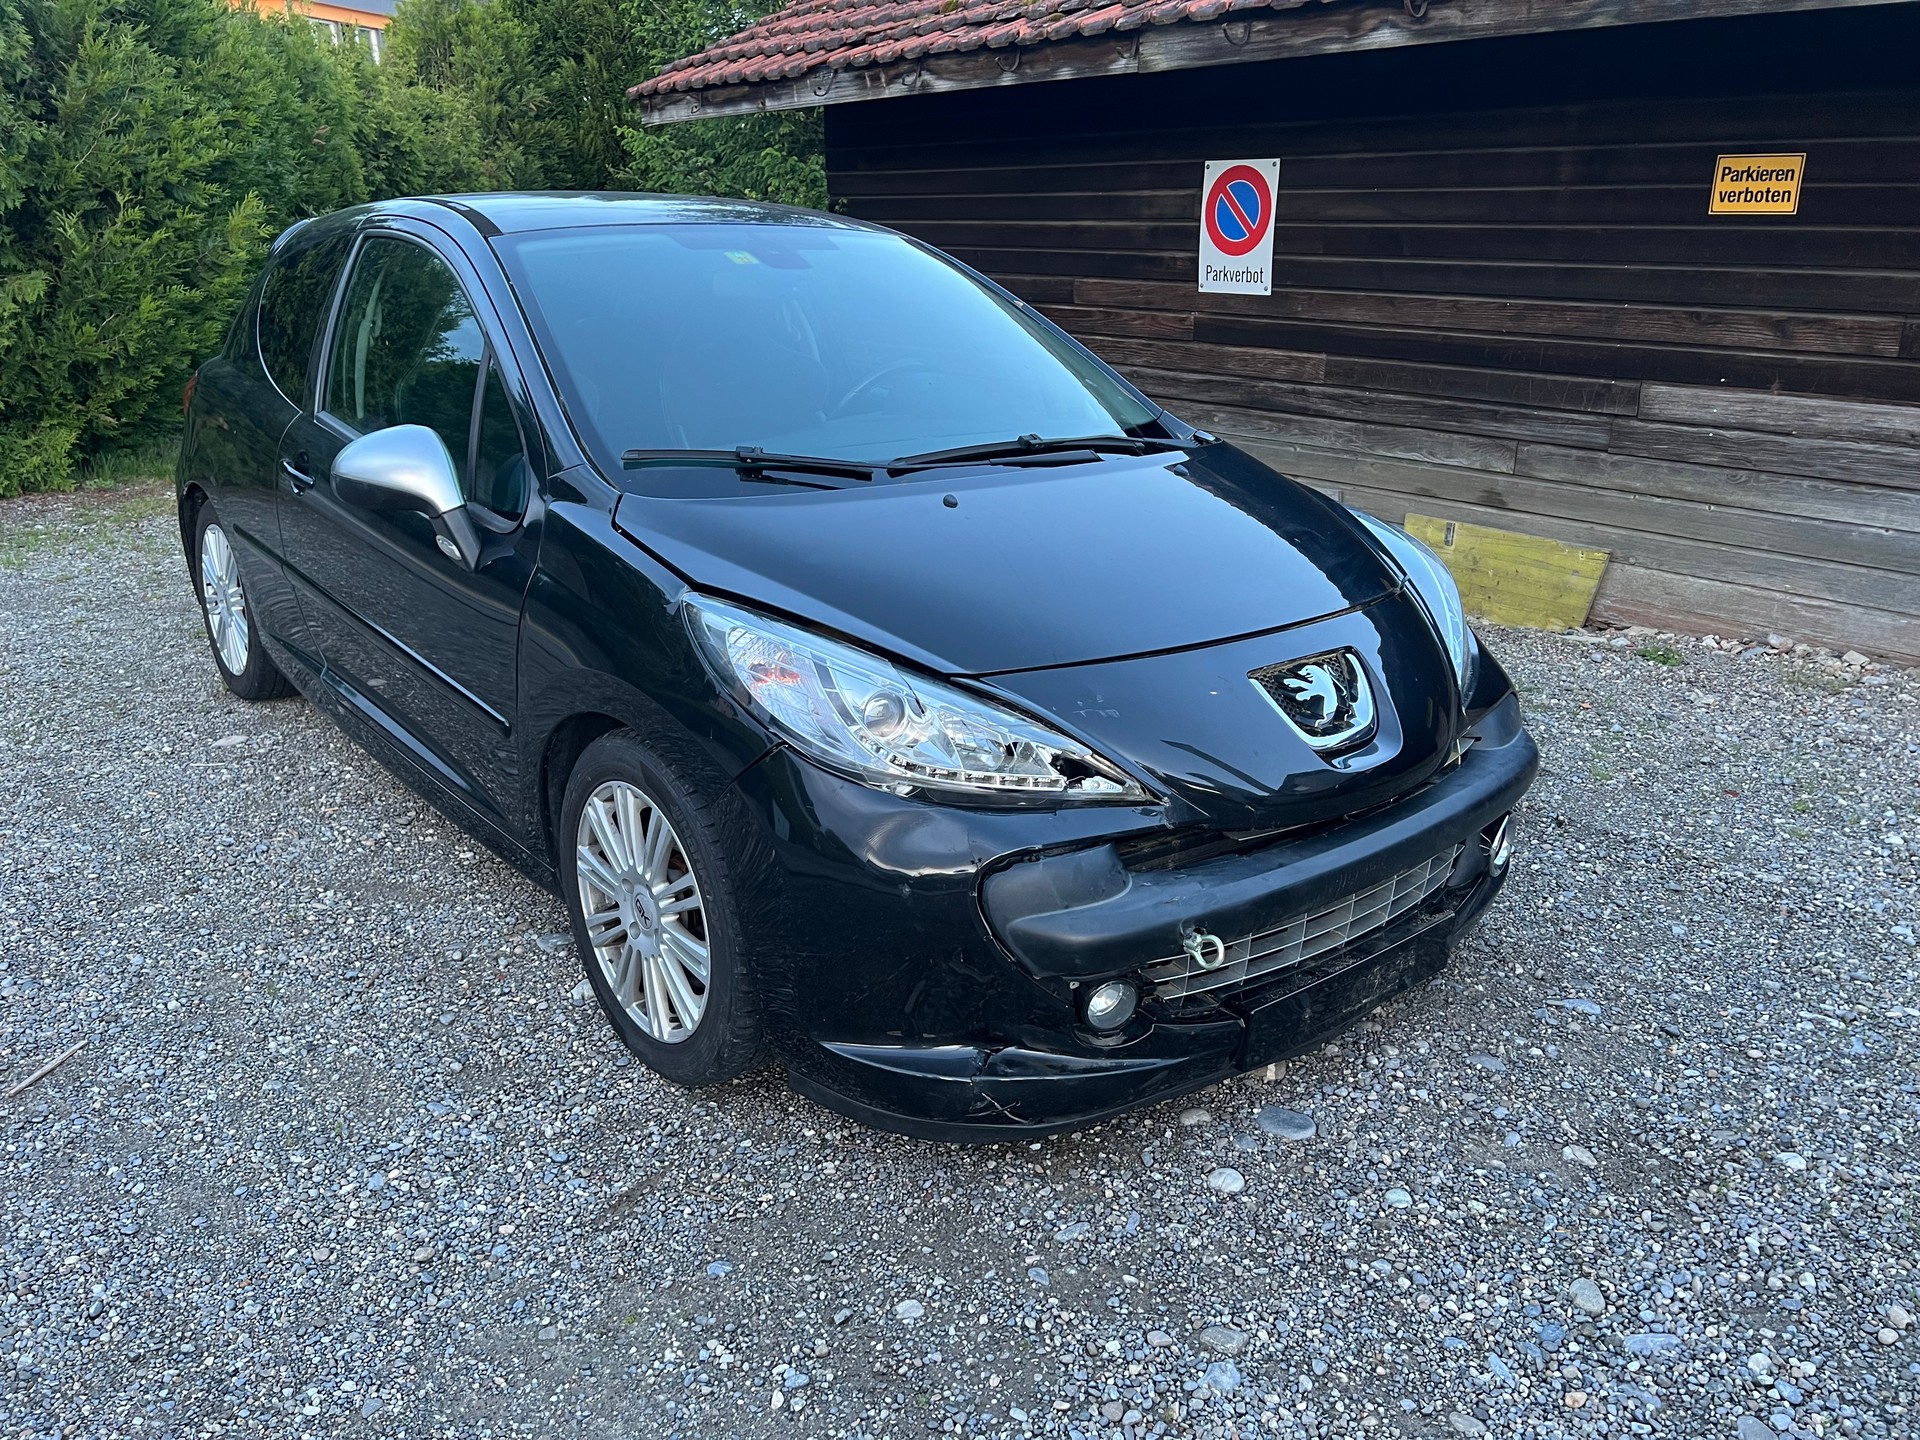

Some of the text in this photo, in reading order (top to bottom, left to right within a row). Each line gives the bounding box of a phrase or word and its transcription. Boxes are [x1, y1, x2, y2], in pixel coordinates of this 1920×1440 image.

[1720, 165, 1796, 182] Parkieren
[1719, 187, 1792, 203] verboten
[1206, 264, 1264, 284] Parkverbot
